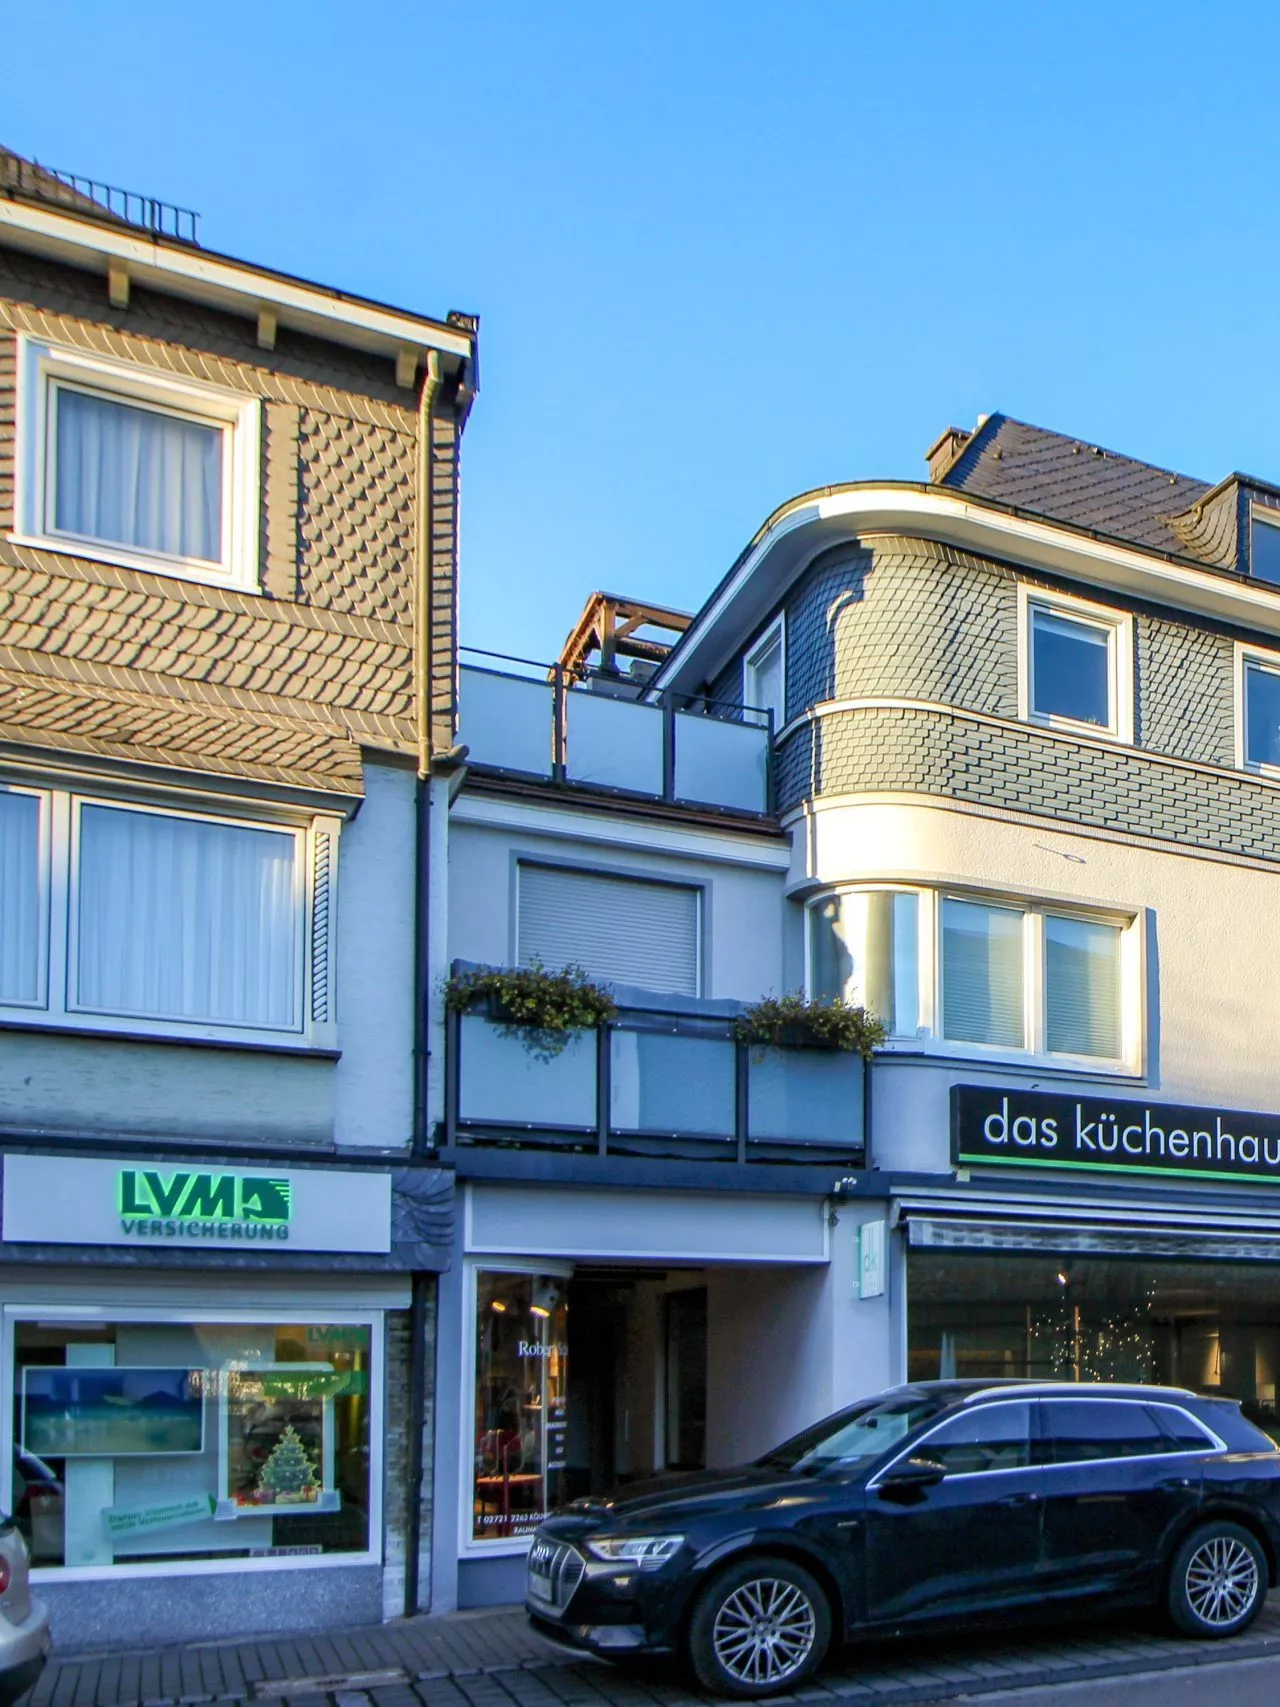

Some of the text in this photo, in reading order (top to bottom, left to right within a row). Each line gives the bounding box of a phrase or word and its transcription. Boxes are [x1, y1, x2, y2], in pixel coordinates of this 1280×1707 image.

[983, 1097, 1058, 1147] das
[121, 1170, 236, 1218] LVM
[120, 1219, 290, 1240] VERSICHERUNG
